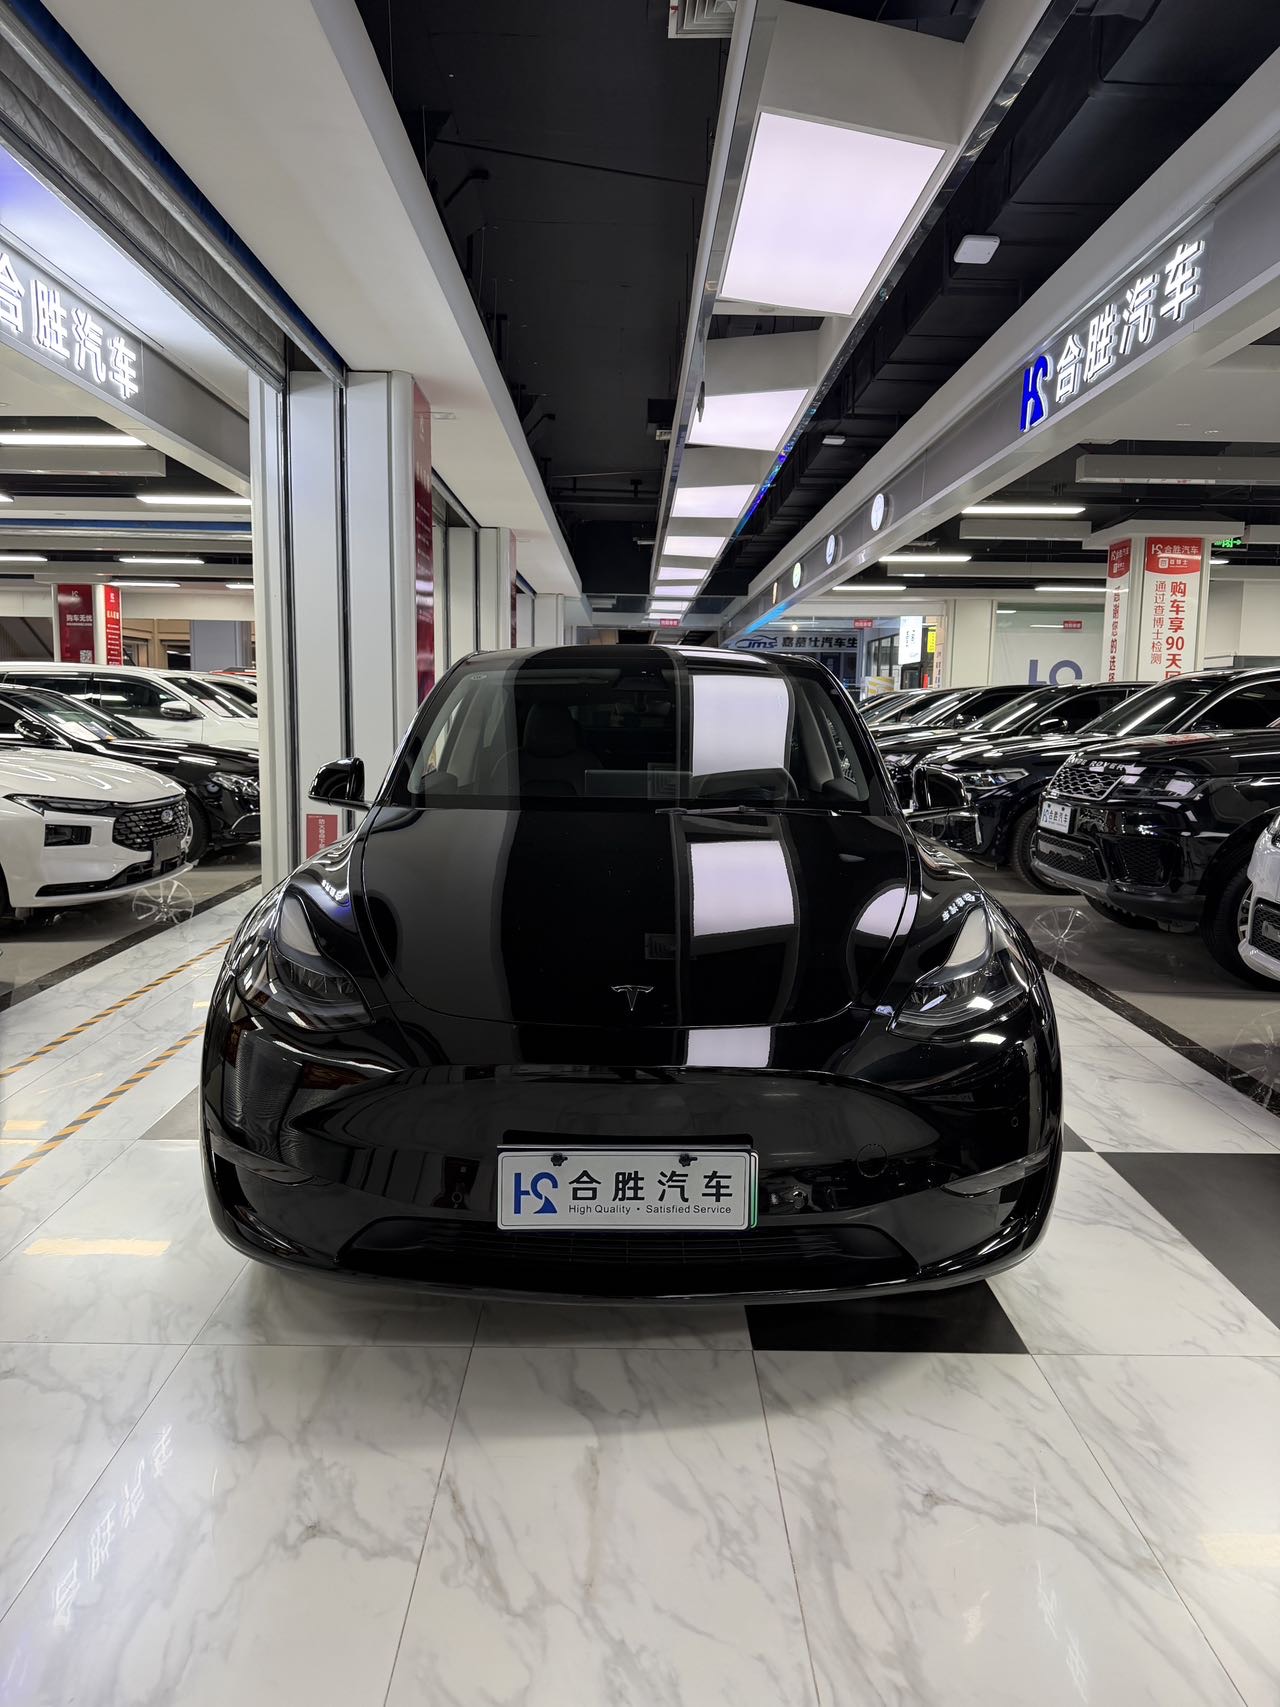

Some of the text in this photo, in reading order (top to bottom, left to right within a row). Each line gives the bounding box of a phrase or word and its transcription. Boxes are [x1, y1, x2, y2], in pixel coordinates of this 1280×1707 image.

[1056, 240, 1205, 403] 合胜汽车
[1164, 545, 1199, 554] 合胜汽车
[1150, 581, 1166, 664] 通过查博士检测
[1089, 760, 1124, 771] ROVER
[568, 1169, 733, 1203] 合胜汽车
[568, 1204, 592, 1215] High
[596, 1204, 631, 1215] Quality
[646, 1204, 690, 1214] Satisfied
[693, 1204, 732, 1214] Service
